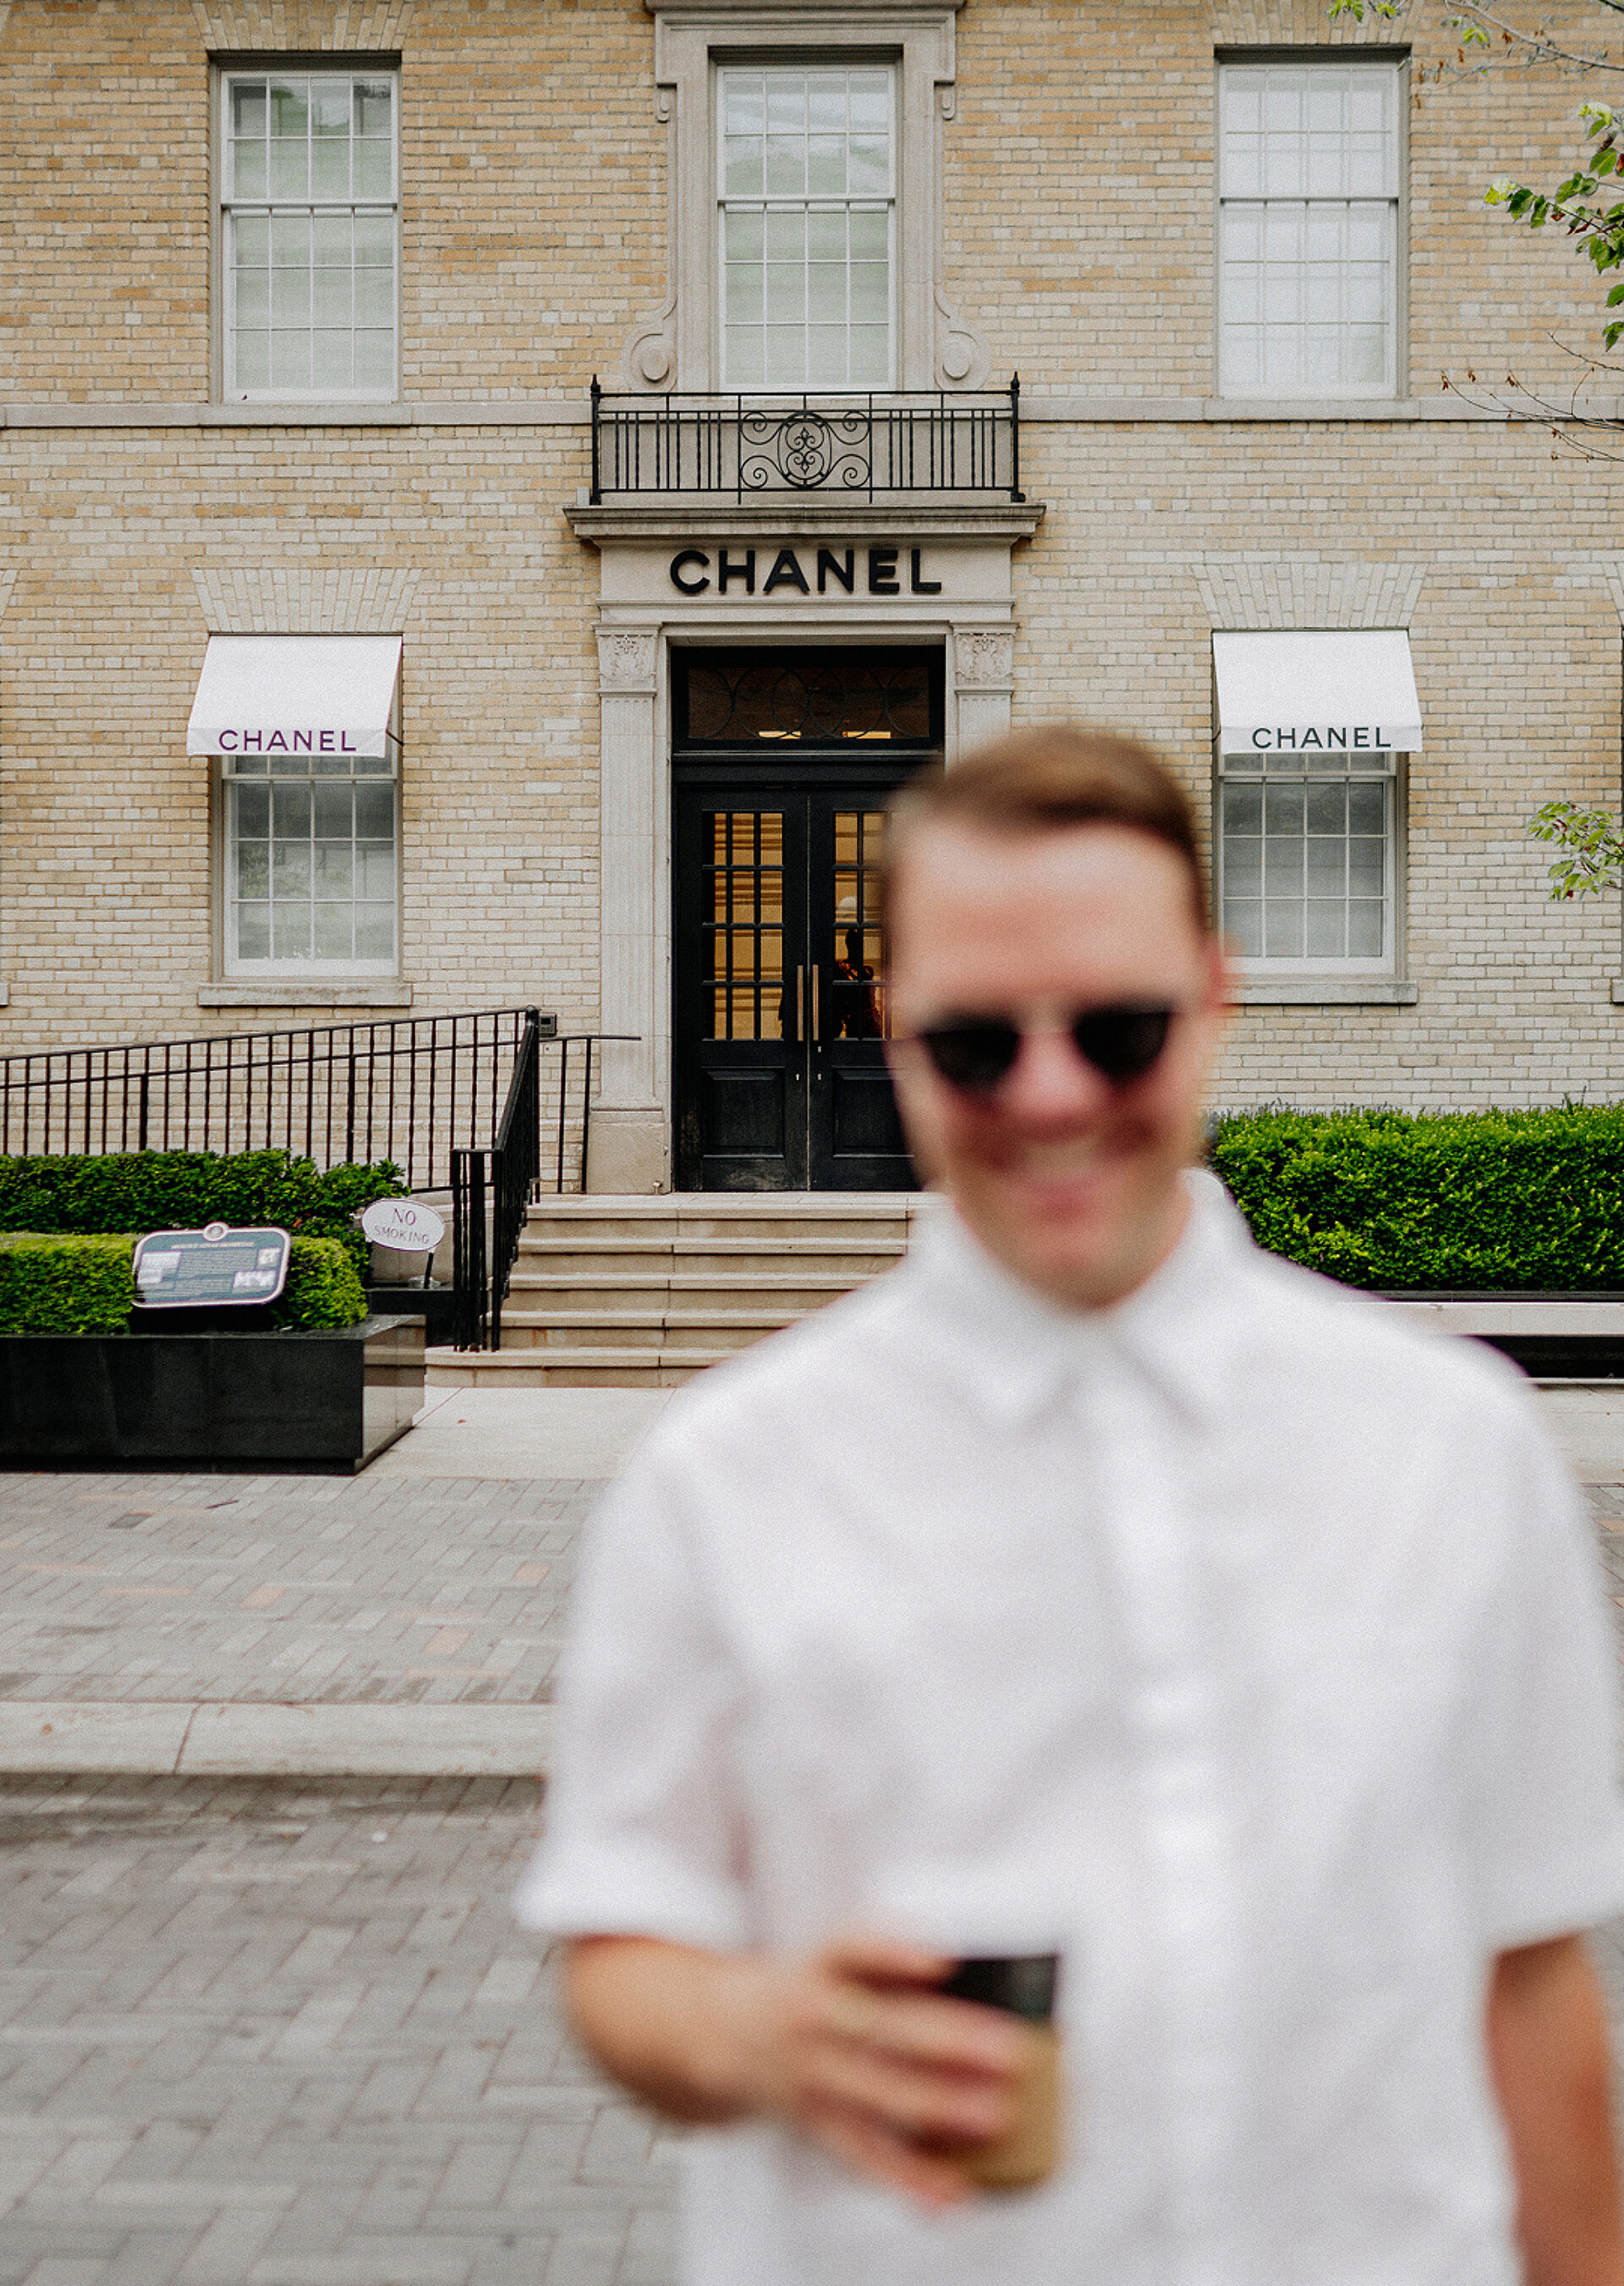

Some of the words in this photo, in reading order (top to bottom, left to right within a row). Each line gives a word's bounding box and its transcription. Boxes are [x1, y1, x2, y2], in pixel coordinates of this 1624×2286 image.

[670, 548, 942, 594] CHANEL
[218, 729, 357, 752] CHANEL
[1252, 727, 1392, 749] CHANEL
[392, 1207, 417, 1227] NO
[373, 1224, 431, 1245] SMOKING
